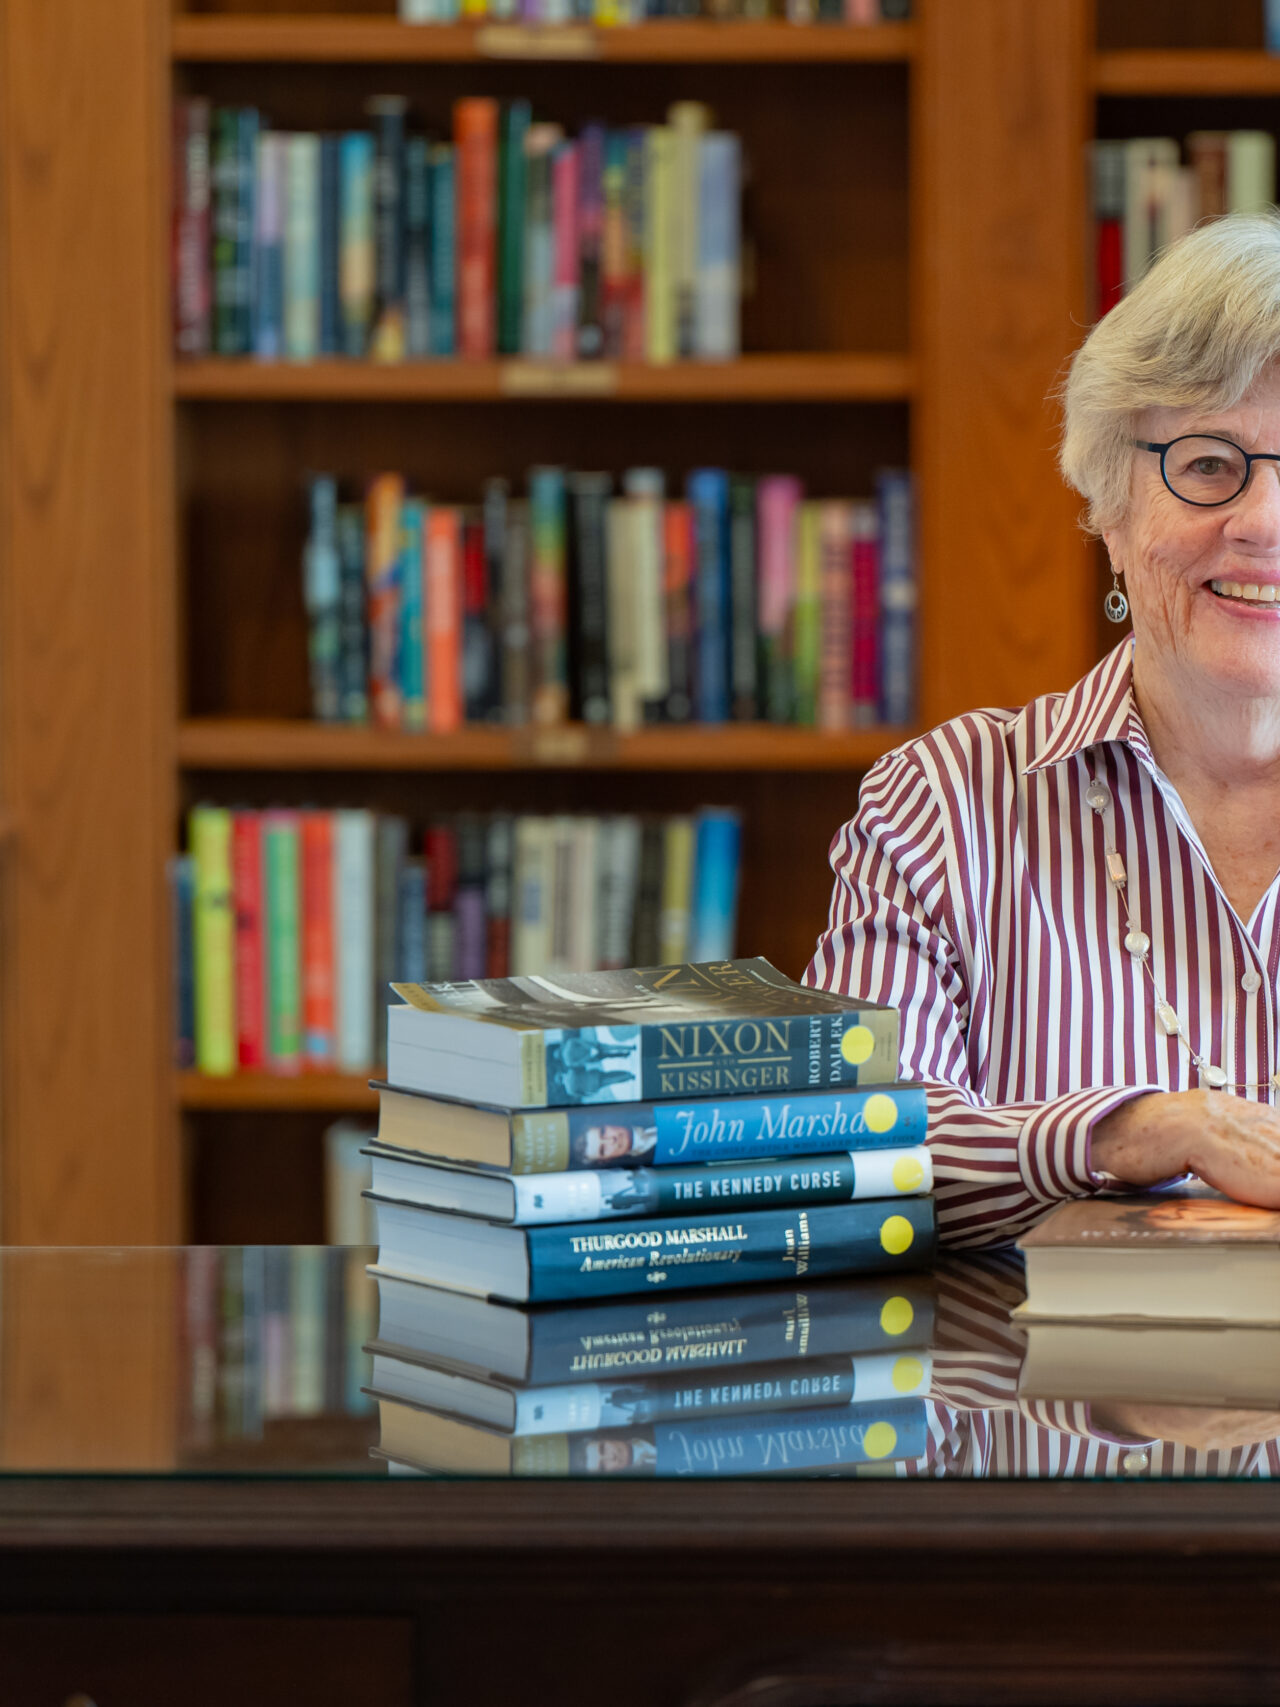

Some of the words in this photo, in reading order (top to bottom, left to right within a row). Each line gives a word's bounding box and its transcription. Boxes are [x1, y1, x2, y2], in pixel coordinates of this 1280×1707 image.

[658, 1020, 793, 1059] NIXON
[808, 1016, 822, 1085] ROBERT
[830, 1016, 843, 1083] DALLEK
[660, 1066, 791, 1093] KISSINGER
[668, 1108, 745, 1156] John
[756, 1100, 874, 1142] Marsha
[674, 1181, 703, 1200] THE
[710, 1175, 783, 1197] KENNEDY
[790, 1171, 841, 1191] CURSE
[570, 1231, 663, 1253] THURGOOD
[665, 1225, 748, 1246] MARSHALL
[783, 1229, 795, 1262] Juan
[796, 1212, 810, 1276] Williams
[580, 1254, 645, 1273] American
[648, 1247, 742, 1268] Revolutionary
